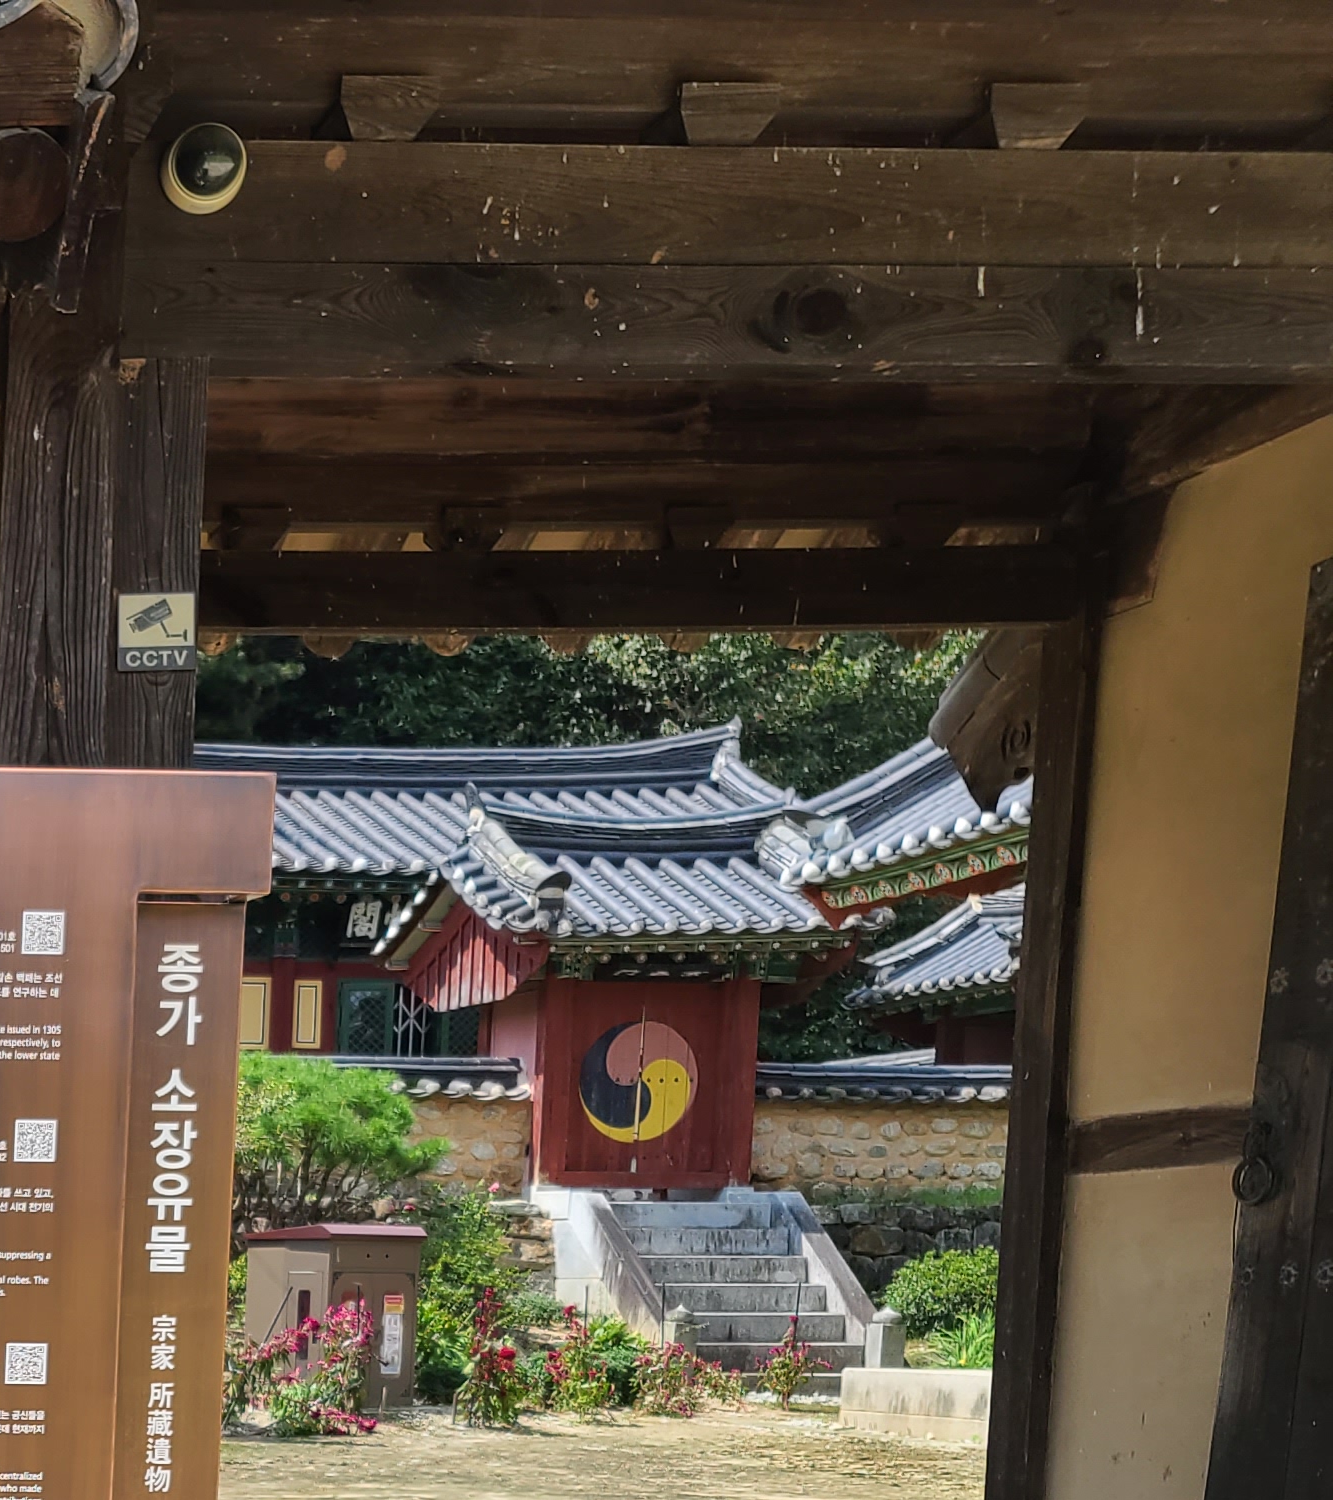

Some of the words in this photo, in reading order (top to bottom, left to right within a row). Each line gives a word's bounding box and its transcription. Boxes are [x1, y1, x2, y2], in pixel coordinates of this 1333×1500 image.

[125, 650, 188, 667] CCTV
[156, 943, 203, 1046] 종가
[145, 1068, 198, 1273] 소장유물
[150, 1315, 176, 1370] 宗家
[144, 1383, 175, 1493] 所藏遺物
